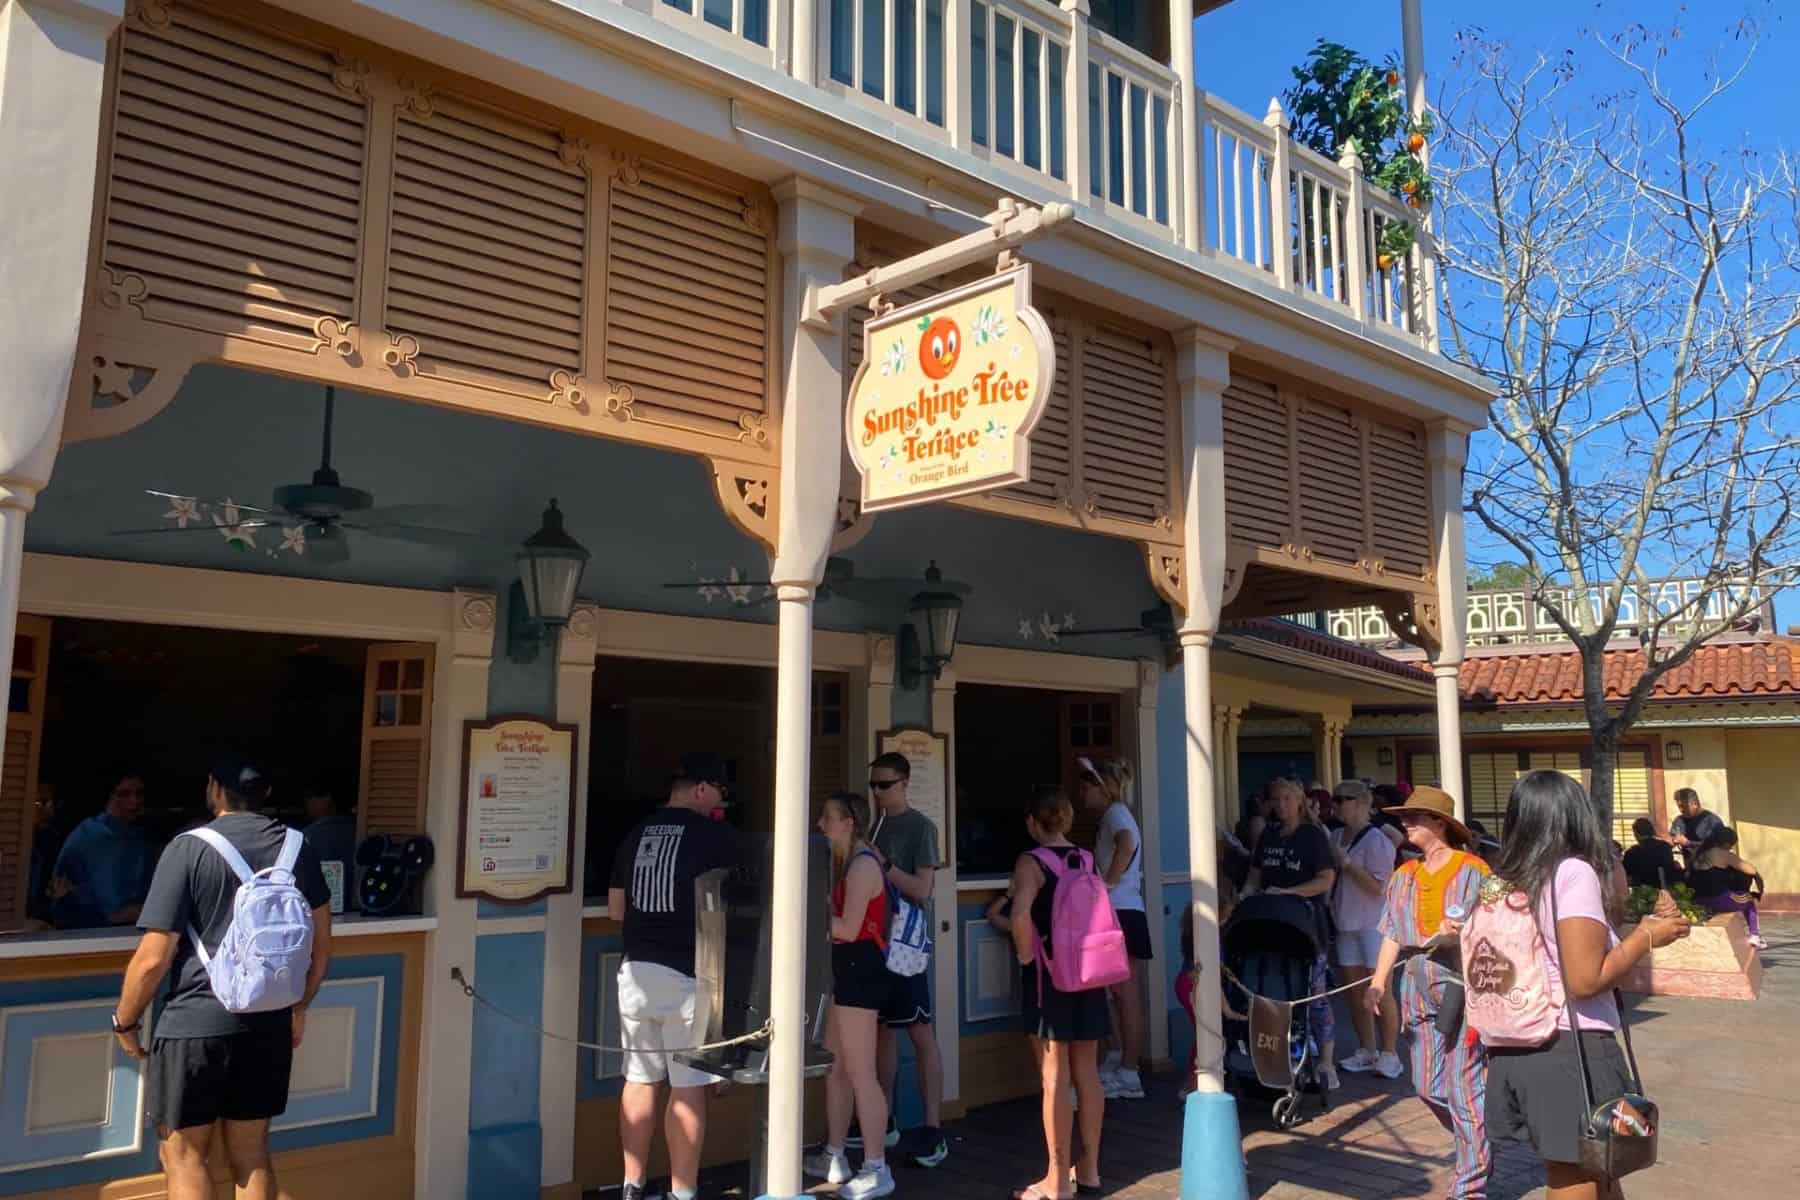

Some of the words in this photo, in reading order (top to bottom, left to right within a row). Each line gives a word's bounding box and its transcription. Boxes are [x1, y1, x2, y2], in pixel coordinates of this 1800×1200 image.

[862, 383, 969, 447] Sunshine
[972, 361, 1029, 406] Tree
[902, 427, 980, 463] Terrace
[1256, 1032, 1281, 1051] EXIT
